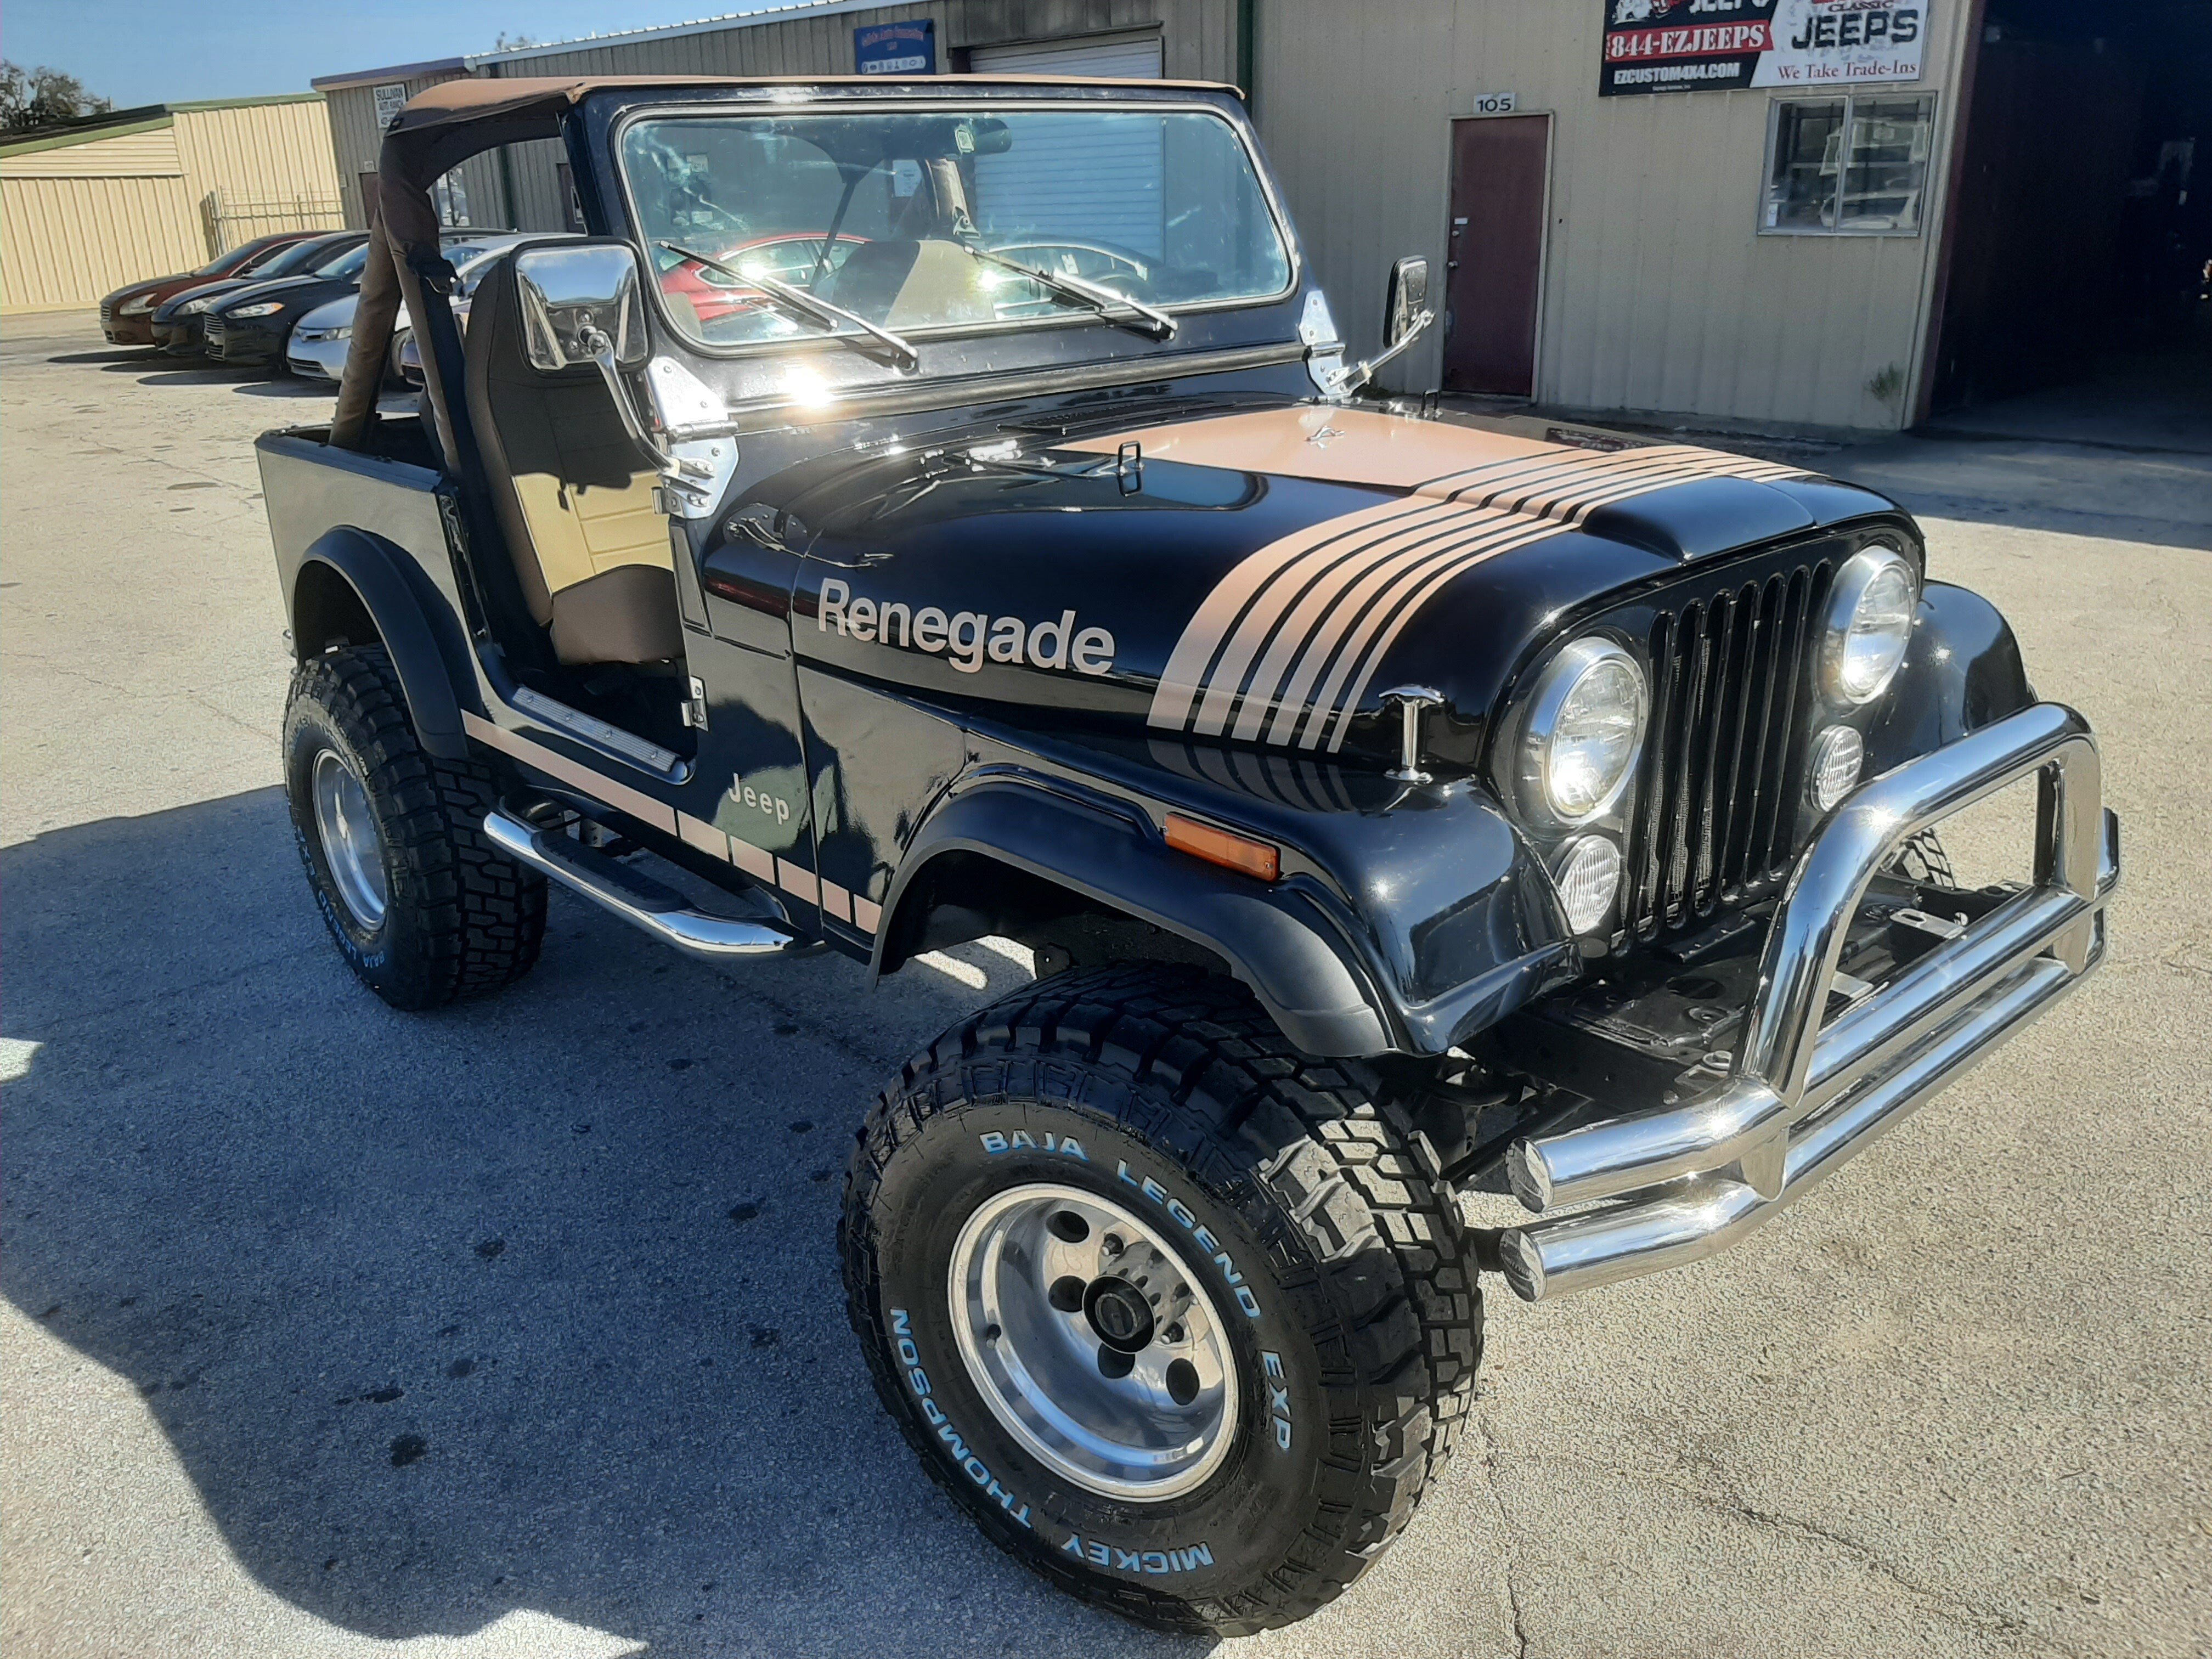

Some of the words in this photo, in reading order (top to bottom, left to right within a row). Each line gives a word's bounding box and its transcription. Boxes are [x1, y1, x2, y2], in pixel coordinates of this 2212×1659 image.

[1828, 0, 1894, 13] CLASSIC
[1791, 9, 1918, 49] JEEPS
[1613, 62, 1741, 85] EZCUSTOM4X4.COM
[1778, 65, 1800, 80] We
[1804, 63, 1839, 78] Take
[1843, 59, 1917, 77] Trade-Ins
[1477, 98, 1511, 112] 105
[817, 577, 1115, 674] Renegade
[727, 772, 790, 825] Jeep
[979, 1129, 1089, 1162] BAJA
[1117, 1159, 1261, 1318] LEGEND
[1262, 1350, 1292, 1450] EXP
[890, 1306, 1034, 1530] THOMPSON
[1062, 1532, 1215, 1575] MICKEY
